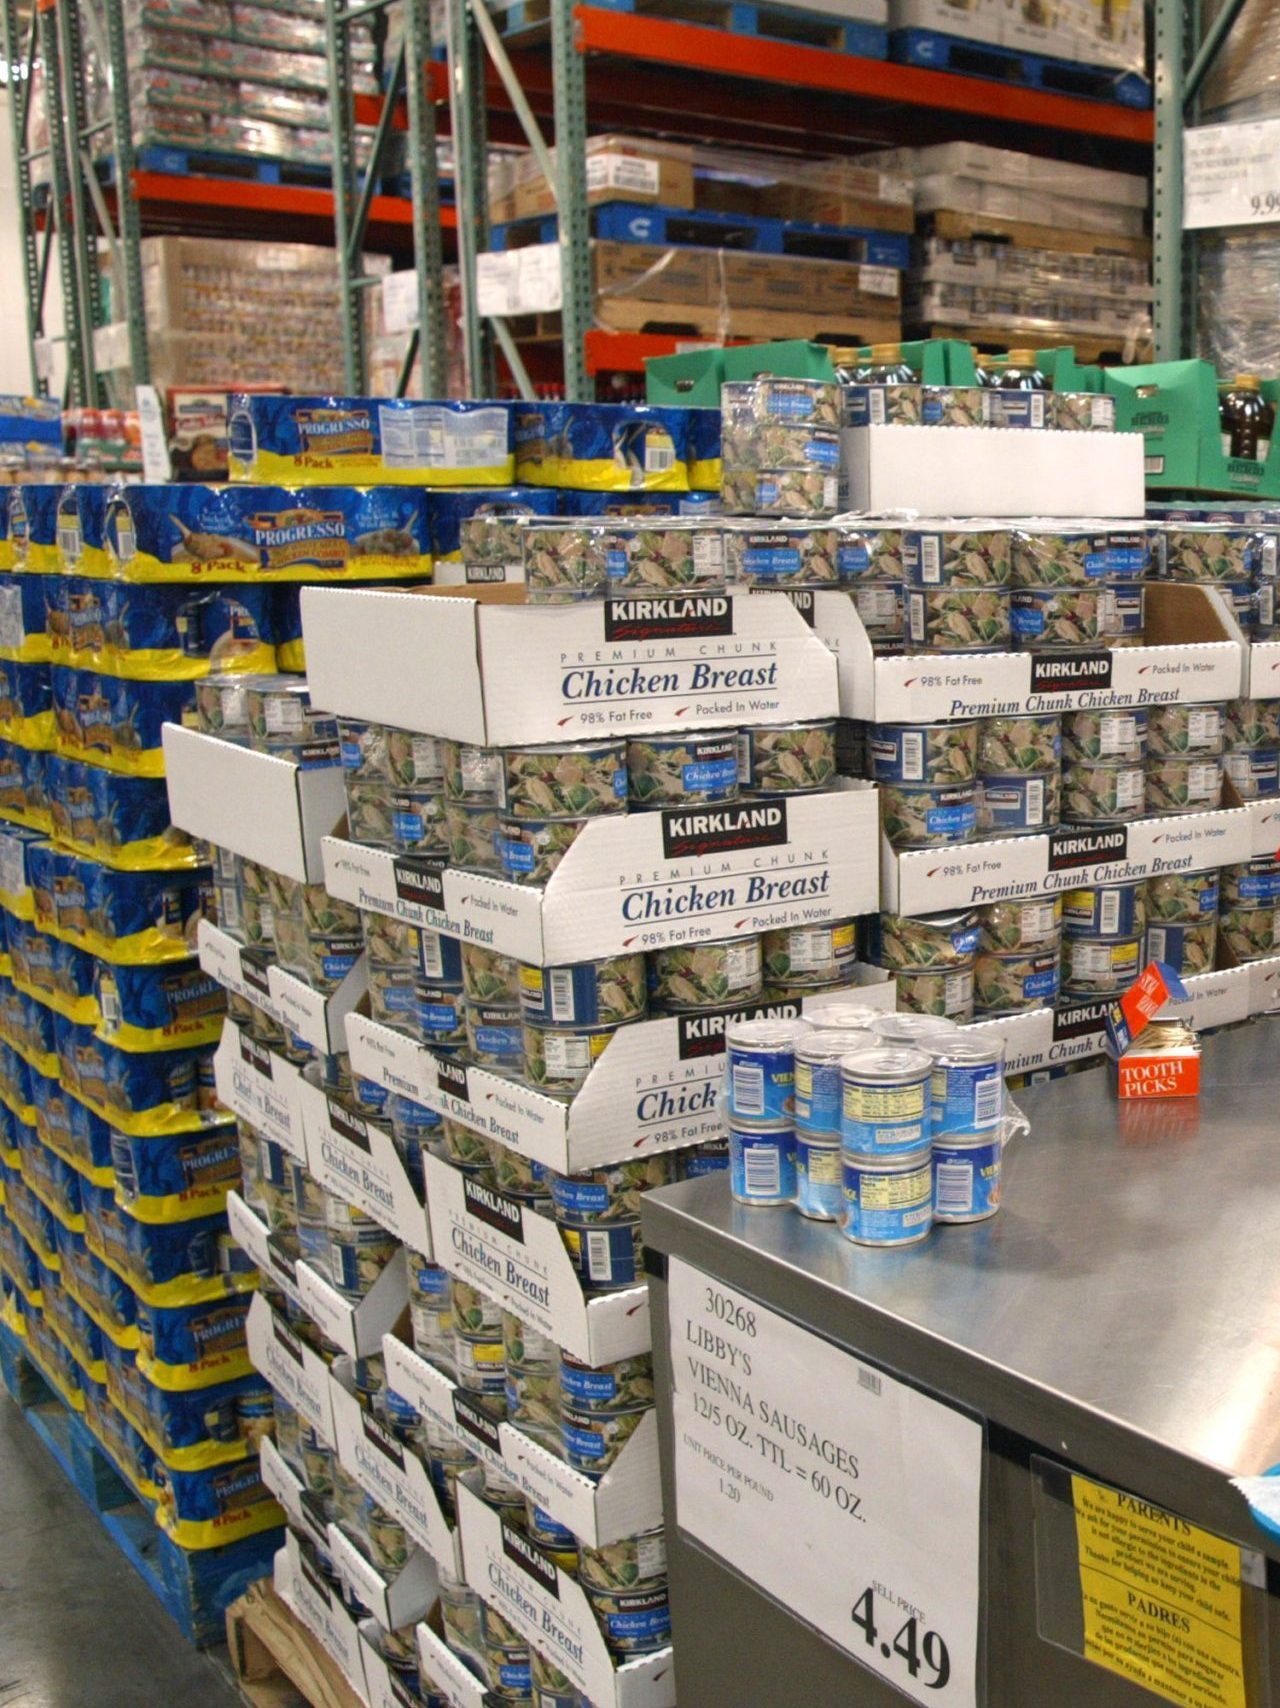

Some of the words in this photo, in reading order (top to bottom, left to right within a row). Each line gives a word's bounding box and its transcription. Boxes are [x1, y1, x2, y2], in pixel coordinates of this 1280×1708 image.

[297, 417, 370, 436] PROGRESSO
[304, 455, 334, 469] Pack
[255, 522, 345, 546] PROGRESSO
[191, 562, 202, 574] 8
[207, 560, 247, 573] Pack
[466, 566, 504, 582] KIRKLAND
[612, 599, 728, 621] KIRKLAND
[560, 647, 675, 663] PREMIUM
[699, 641, 777, 655] CHUNK
[562, 667, 679, 699] Chicken
[689, 662, 778, 690] Breast
[921, 675, 942, 687] 98%
[945, 675, 960, 686] Fat
[963, 674, 983, 685] Free
[1035, 659, 1110, 678] KIRKLAND
[1152, 663, 1182, 675] Packed
[1192, 662, 1216, 673] Water
[581, 712, 605, 725] 98%
[609, 711, 626, 722] Fat
[630, 709, 652, 721] Free
[696, 702, 734, 716] Packed
[736, 702, 745, 713] In
[749, 699, 780, 712] Water
[950, 698, 1020, 717] Premium
[1025, 695, 1073, 712] Chunk
[1078, 690, 1135, 709] Chicken
[1137, 687, 1180, 704] Breast
[685, 770, 719, 782] Chicken
[669, 808, 782, 838] KIRKLAND
[929, 814, 958, 825] Chicken
[1053, 832, 1124, 856] KIRKLAND
[1165, 831, 1193, 844] Packed
[1204, 826, 1227, 839] Water
[508, 851, 532, 862] Breast
[619, 862, 731, 885] PREMIUM
[753, 849, 829, 868] CHUNK
[943, 865, 963, 877] 98%
[966, 862, 981, 875] Fat
[983, 860, 1002, 872] Free
[395, 867, 441, 893] KIRKLAND
[971, 879, 1038, 902] Premium
[1043, 871, 1089, 891] Chunk
[1094, 862, 1147, 882] Chicken
[1151, 854, 1193, 874] Breast
[622, 883, 736, 921] Chicken
[745, 869, 830, 904] Breast
[359, 887, 394, 914] Premium
[396, 897, 424, 924] Chunk
[425, 909, 461, 935] Chicken
[463, 919, 494, 944] Breast
[641, 932, 665, 946] 98%
[669, 930, 686, 942] Fat
[689, 926, 711, 939] Free
[752, 914, 787, 928] Packed
[790, 912, 799, 922] In
[802, 907, 832, 920] Water
[166, 977, 221, 1002] PROGRE
[1206, 985, 1228, 998] Water
[173, 1021, 205, 1034] Pack
[1050, 1036, 1093, 1060] Chunk
[636, 1062, 726, 1087] PREMIU
[1121, 1059, 1184, 1083] TOOTH
[1125, 1076, 1178, 1097] PICKS
[383, 1066, 419, 1096] Premium
[451, 1099, 487, 1129] Chicken
[489, 1116, 519, 1146] Breast
[637, 1082, 717, 1121] Chick
[654, 1130, 678, 1144] 98%
[681, 1126, 697, 1138] Fat
[701, 1122, 723, 1134] Free
[182, 1149, 230, 1172] PROGRE
[321, 1142, 360, 1184] Chicken
[362, 1169, 394, 1209] Breast
[188, 1187, 221, 1199] Pack
[465, 1179, 520, 1223] KIRKLAND
[575, 1191, 606, 1202] Breast
[452, 1226, 502, 1277] Chicken
[506, 1258, 550, 1307] Breast
[705, 1287, 757, 1338] 30268
[193, 1316, 246, 1343] PROGRE
[686, 1319, 752, 1376] LIBBY'S
[688, 1356, 754, 1415] VIENNA
[759, 1400, 860, 1480] SAUSAGES
[683, 1432, 702, 1452] UNIT
[703, 1447, 727, 1472] PRICE
[727, 1463, 743, 1481] PER
[744, 1474, 774, 1502] POUND
[693, 1391, 722, 1426] 12/5
[725, 1414, 753, 1449] OZ.
[756, 1433, 792, 1474] TTL
[796, 1465, 807, 1480] =
[811, 1470, 831, 1499] 60
[835, 1485, 867, 1523] OZ.
[719, 1477, 741, 1503] 1.20
[1116, 1493, 1192, 1536] PARENTS
[1107, 1506, 1128, 1527] happy
[1158, 1531, 1176, 1545] your
[1177, 1539, 1195, 1554] child
[1129, 1530, 1167, 1554] permission
[503, 1524, 556, 1581] KIRKLAND
[1085, 1545, 1110, 1563] Thanks
[1123, 1561, 1150, 1583] helping
[620, 1592, 667, 1607] KIRKLAND
[872, 1580, 895, 1604] SELL
[897, 1596, 926, 1625] PRICE
[1127, 1590, 1191, 1634] PADRES
[488, 1562, 537, 1622] Chicken
[541, 1609, 584, 1665] Breast
[610, 1618, 647, 1629] Chicken
[851, 1586, 950, 1690] 4.49
